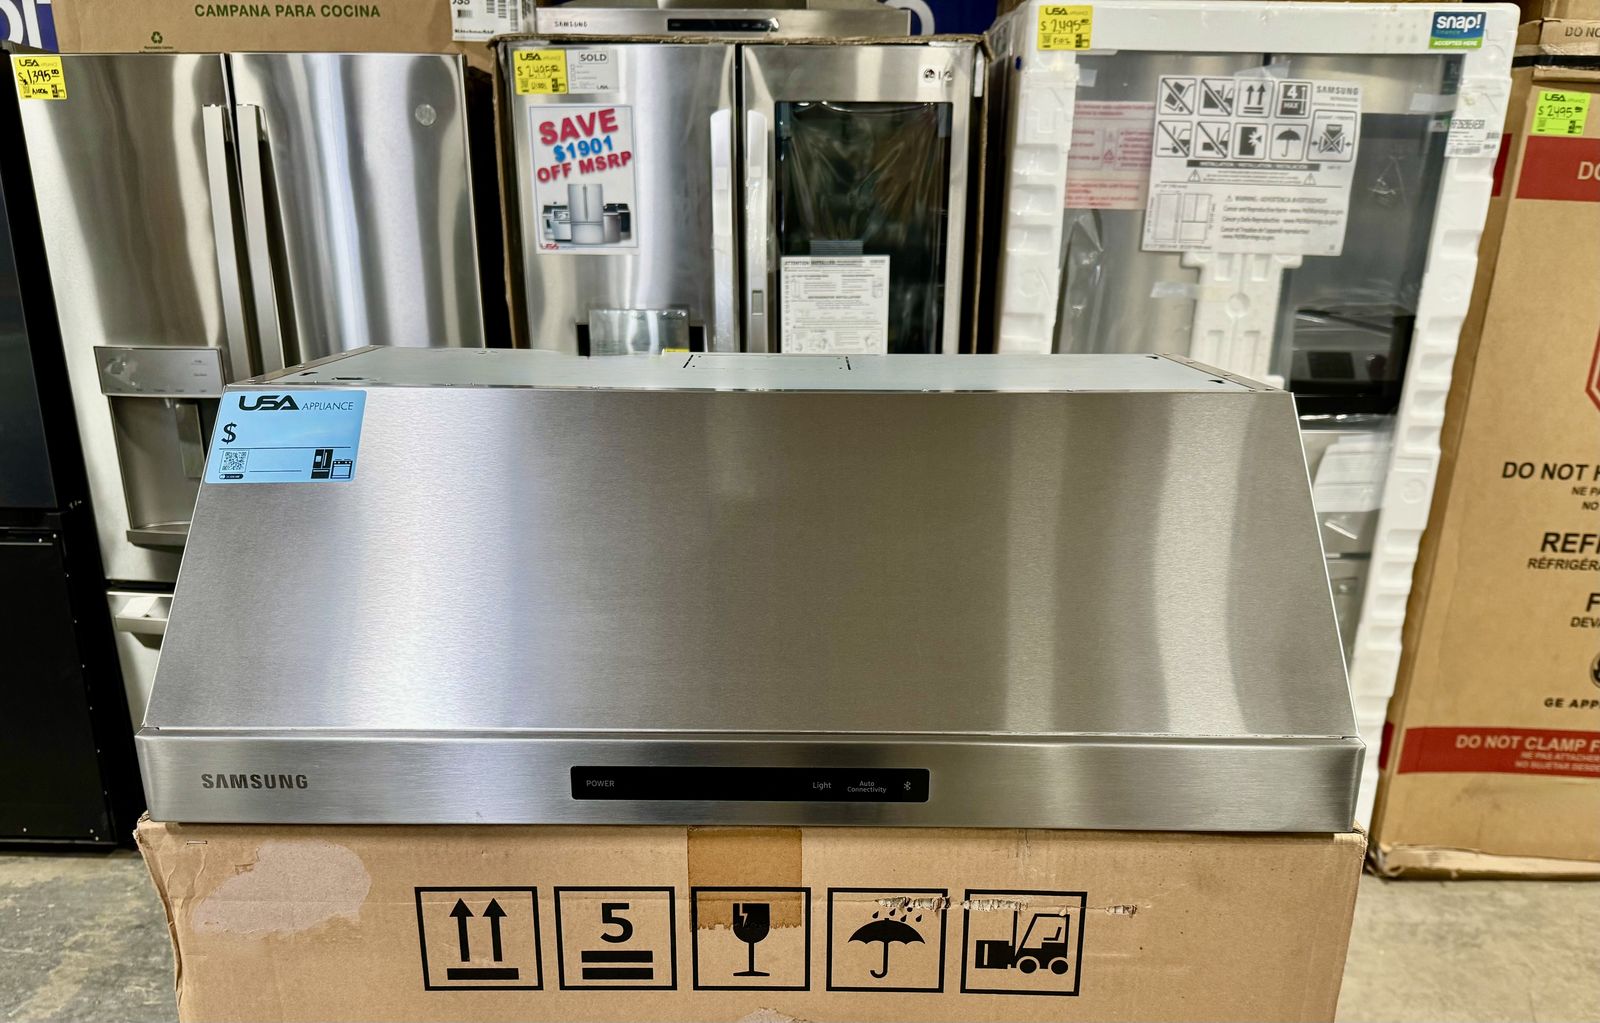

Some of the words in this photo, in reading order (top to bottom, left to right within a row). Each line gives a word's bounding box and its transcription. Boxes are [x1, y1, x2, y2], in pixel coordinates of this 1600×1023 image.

[194, 4, 271, 17] CAMPANA
[275, 5, 316, 17] PARA
[320, 4, 381, 17] COCINA
[1045, 7, 1068, 15] USA
[1436, 14, 1482, 33] snap!
[1565, 26, 1584, 37] DO
[18, 59, 40, 67] USA
[520, 53, 542, 61] USA
[580, 54, 607, 62] SOLD
[1286, 86, 1299, 99] 4
[1316, 85, 1359, 95] SAMSUNG
[1544, 93, 1567, 102] USA
[538, 107, 619, 146] SAVE
[553, 134, 614, 164] $1901
[536, 162, 573, 184] OFF
[578, 150, 633, 175] MSRP
[239, 395, 300, 411] USA
[302, 401, 354, 411] APPLIANCE
[221, 422, 238, 444] $
[1502, 461, 1535, 479] DO
[1541, 463, 1589, 481] NOT
[1571, 486, 1587, 496] NE
[1582, 501, 1599, 511] NO
[1527, 556, 1600, 572] RÉFRIGÉR
[1543, 697, 1564, 709] GE
[1455, 734, 1482, 749] DO
[1484, 735, 1522, 750] NOT
[1524, 736, 1587, 752] CLAMP
[200, 773, 309, 789] SAMSUNG
[586, 779, 615, 788] POWER
[812, 781, 832, 790] Light
[847, 786, 887, 794] Connectivity
[600, 903, 633, 943] 5
